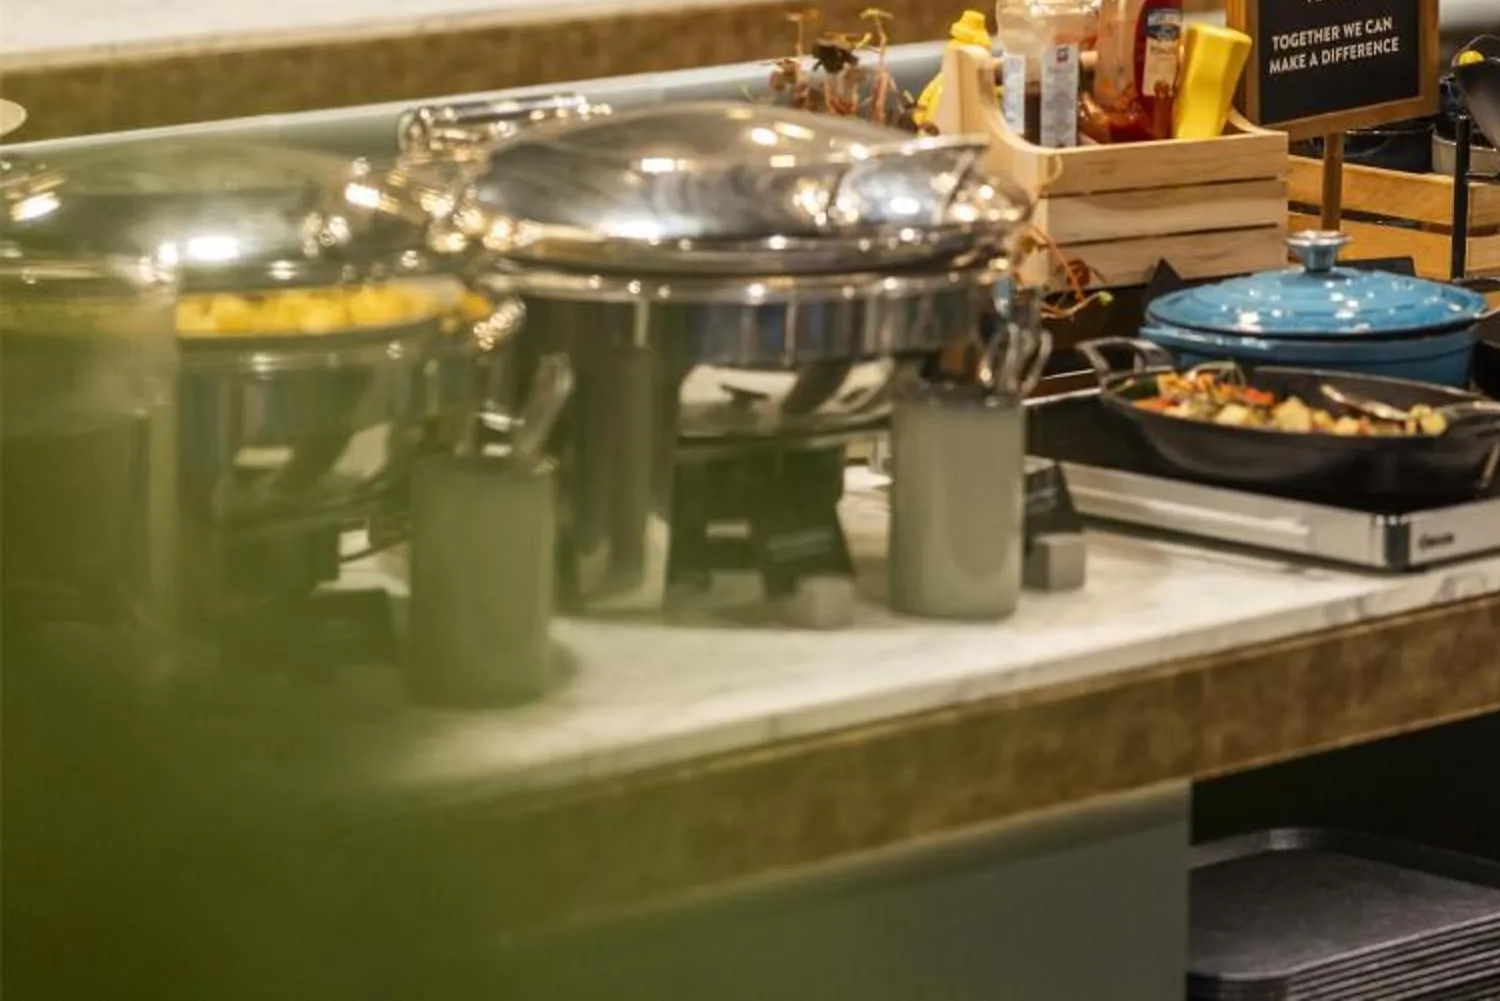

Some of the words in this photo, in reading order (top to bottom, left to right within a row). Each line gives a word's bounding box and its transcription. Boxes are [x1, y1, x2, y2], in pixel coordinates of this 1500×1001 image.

[1272, 25, 1341, 51] TOGETHER
[1343, 20, 1363, 38] WE
[1365, 15, 1393, 34] CAN
[1269, 53, 1307, 75] MAKE
[1309, 50, 1319, 68] A
[1321, 36, 1400, 65] DIFFERENCE
